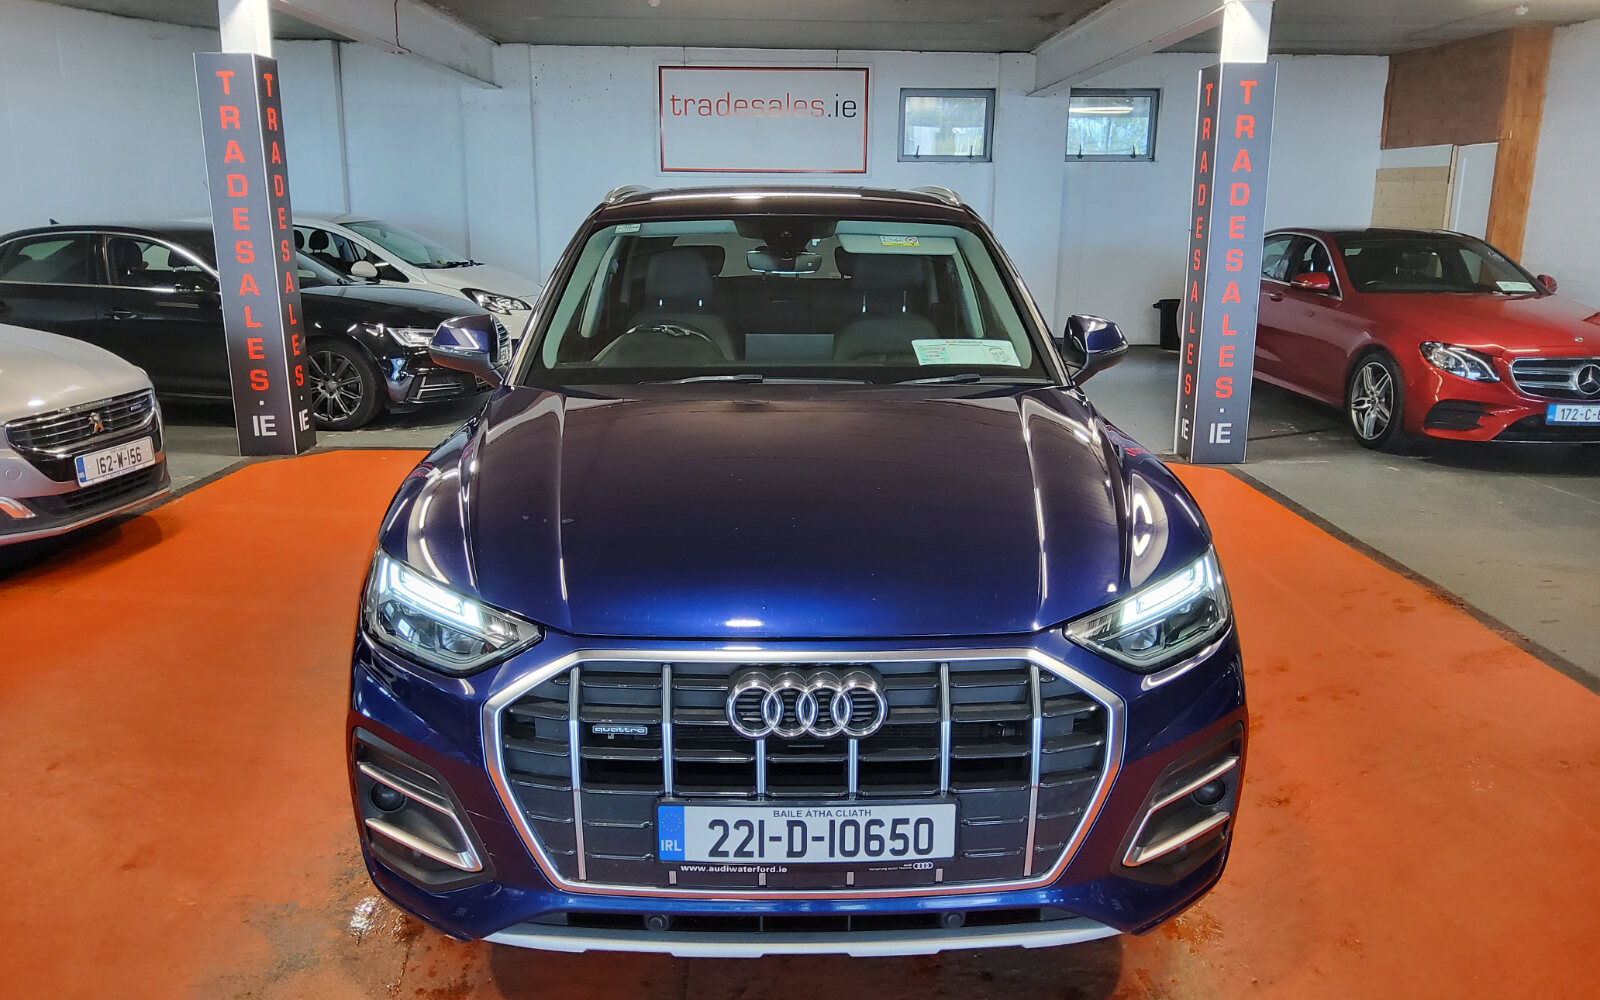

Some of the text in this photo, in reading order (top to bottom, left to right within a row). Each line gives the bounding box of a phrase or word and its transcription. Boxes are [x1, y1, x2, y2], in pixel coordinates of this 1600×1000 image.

[669, 91, 857, 119] tradesales.ie
[95, 446, 142, 475] 162-W-156
[773, 808, 872, 818] BAILE ÁTHA CLIATH
[660, 839, 683, 852] IRL
[708, 816, 934, 858] 221-D-10650
[680, 865, 788, 873] www.audiwaterford.ie
